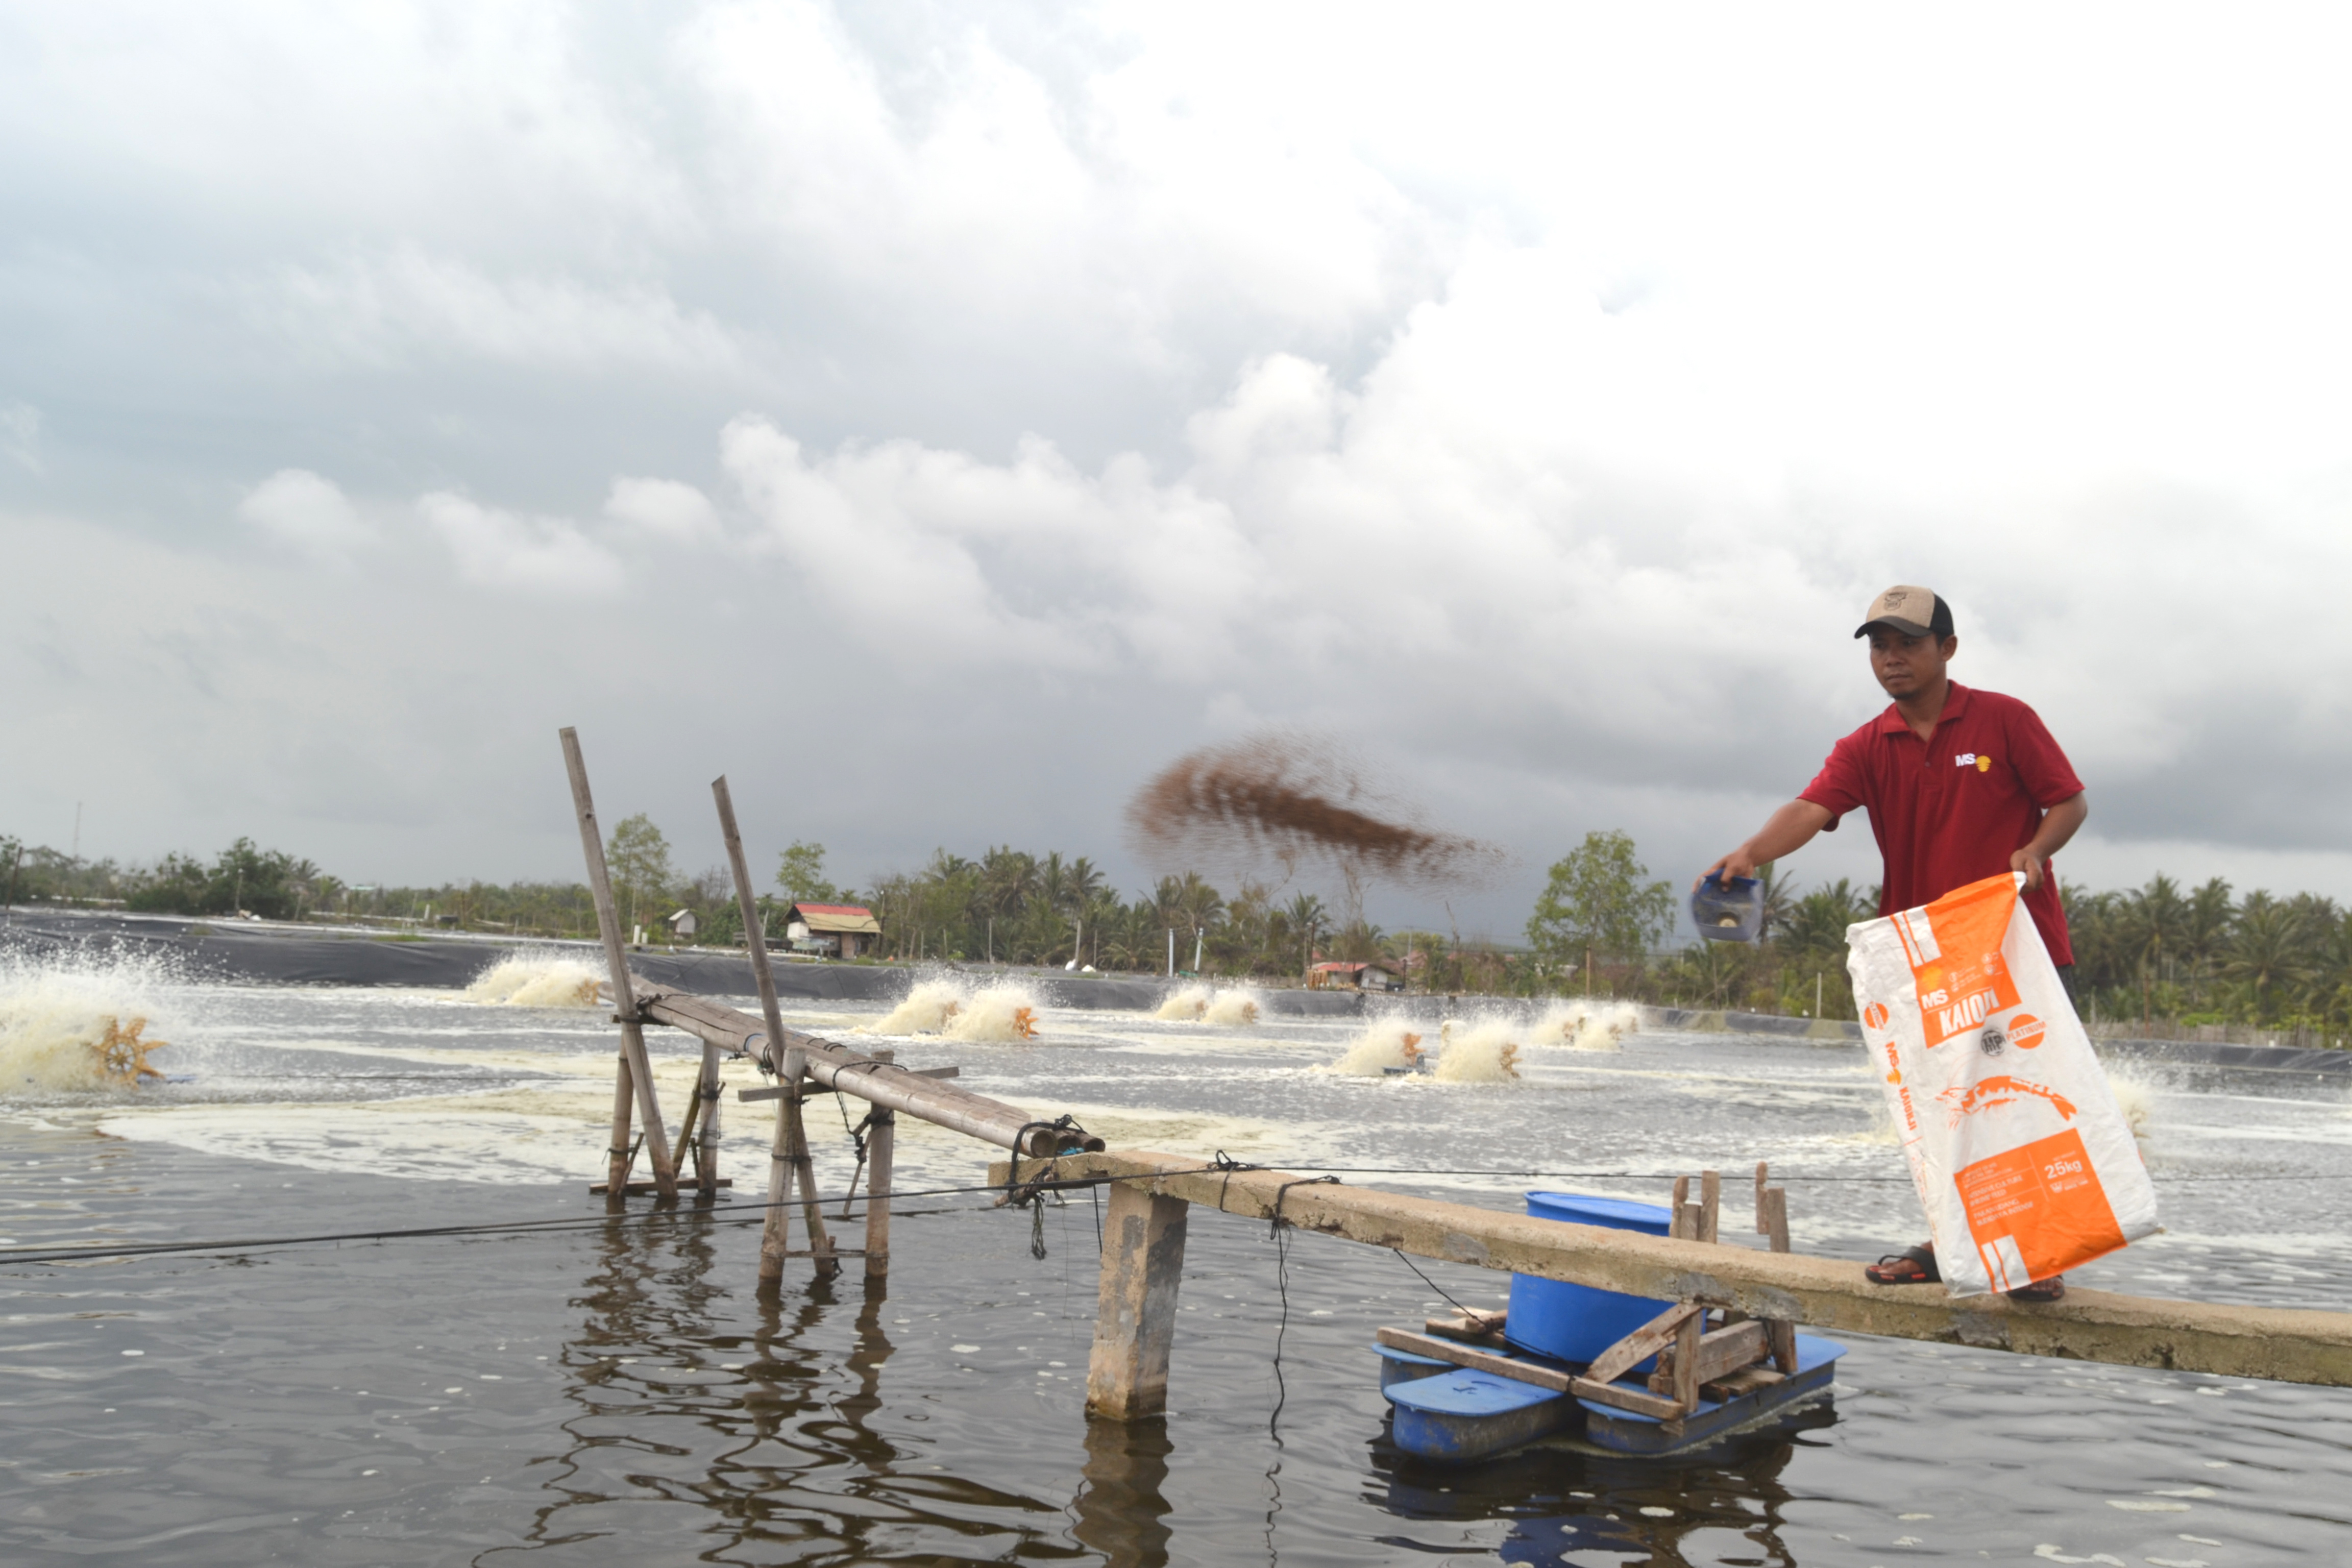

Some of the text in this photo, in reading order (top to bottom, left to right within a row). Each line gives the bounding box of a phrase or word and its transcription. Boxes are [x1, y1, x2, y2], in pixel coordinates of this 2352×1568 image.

[1955, 753, 1976, 767] MS
[1921, 989, 1949, 1009] MS
[2005, 1020, 2048, 1041] PLATINUM
[1885, 1041, 1900, 1068] MS
[2044, 1160, 2082, 1180] 25kg
